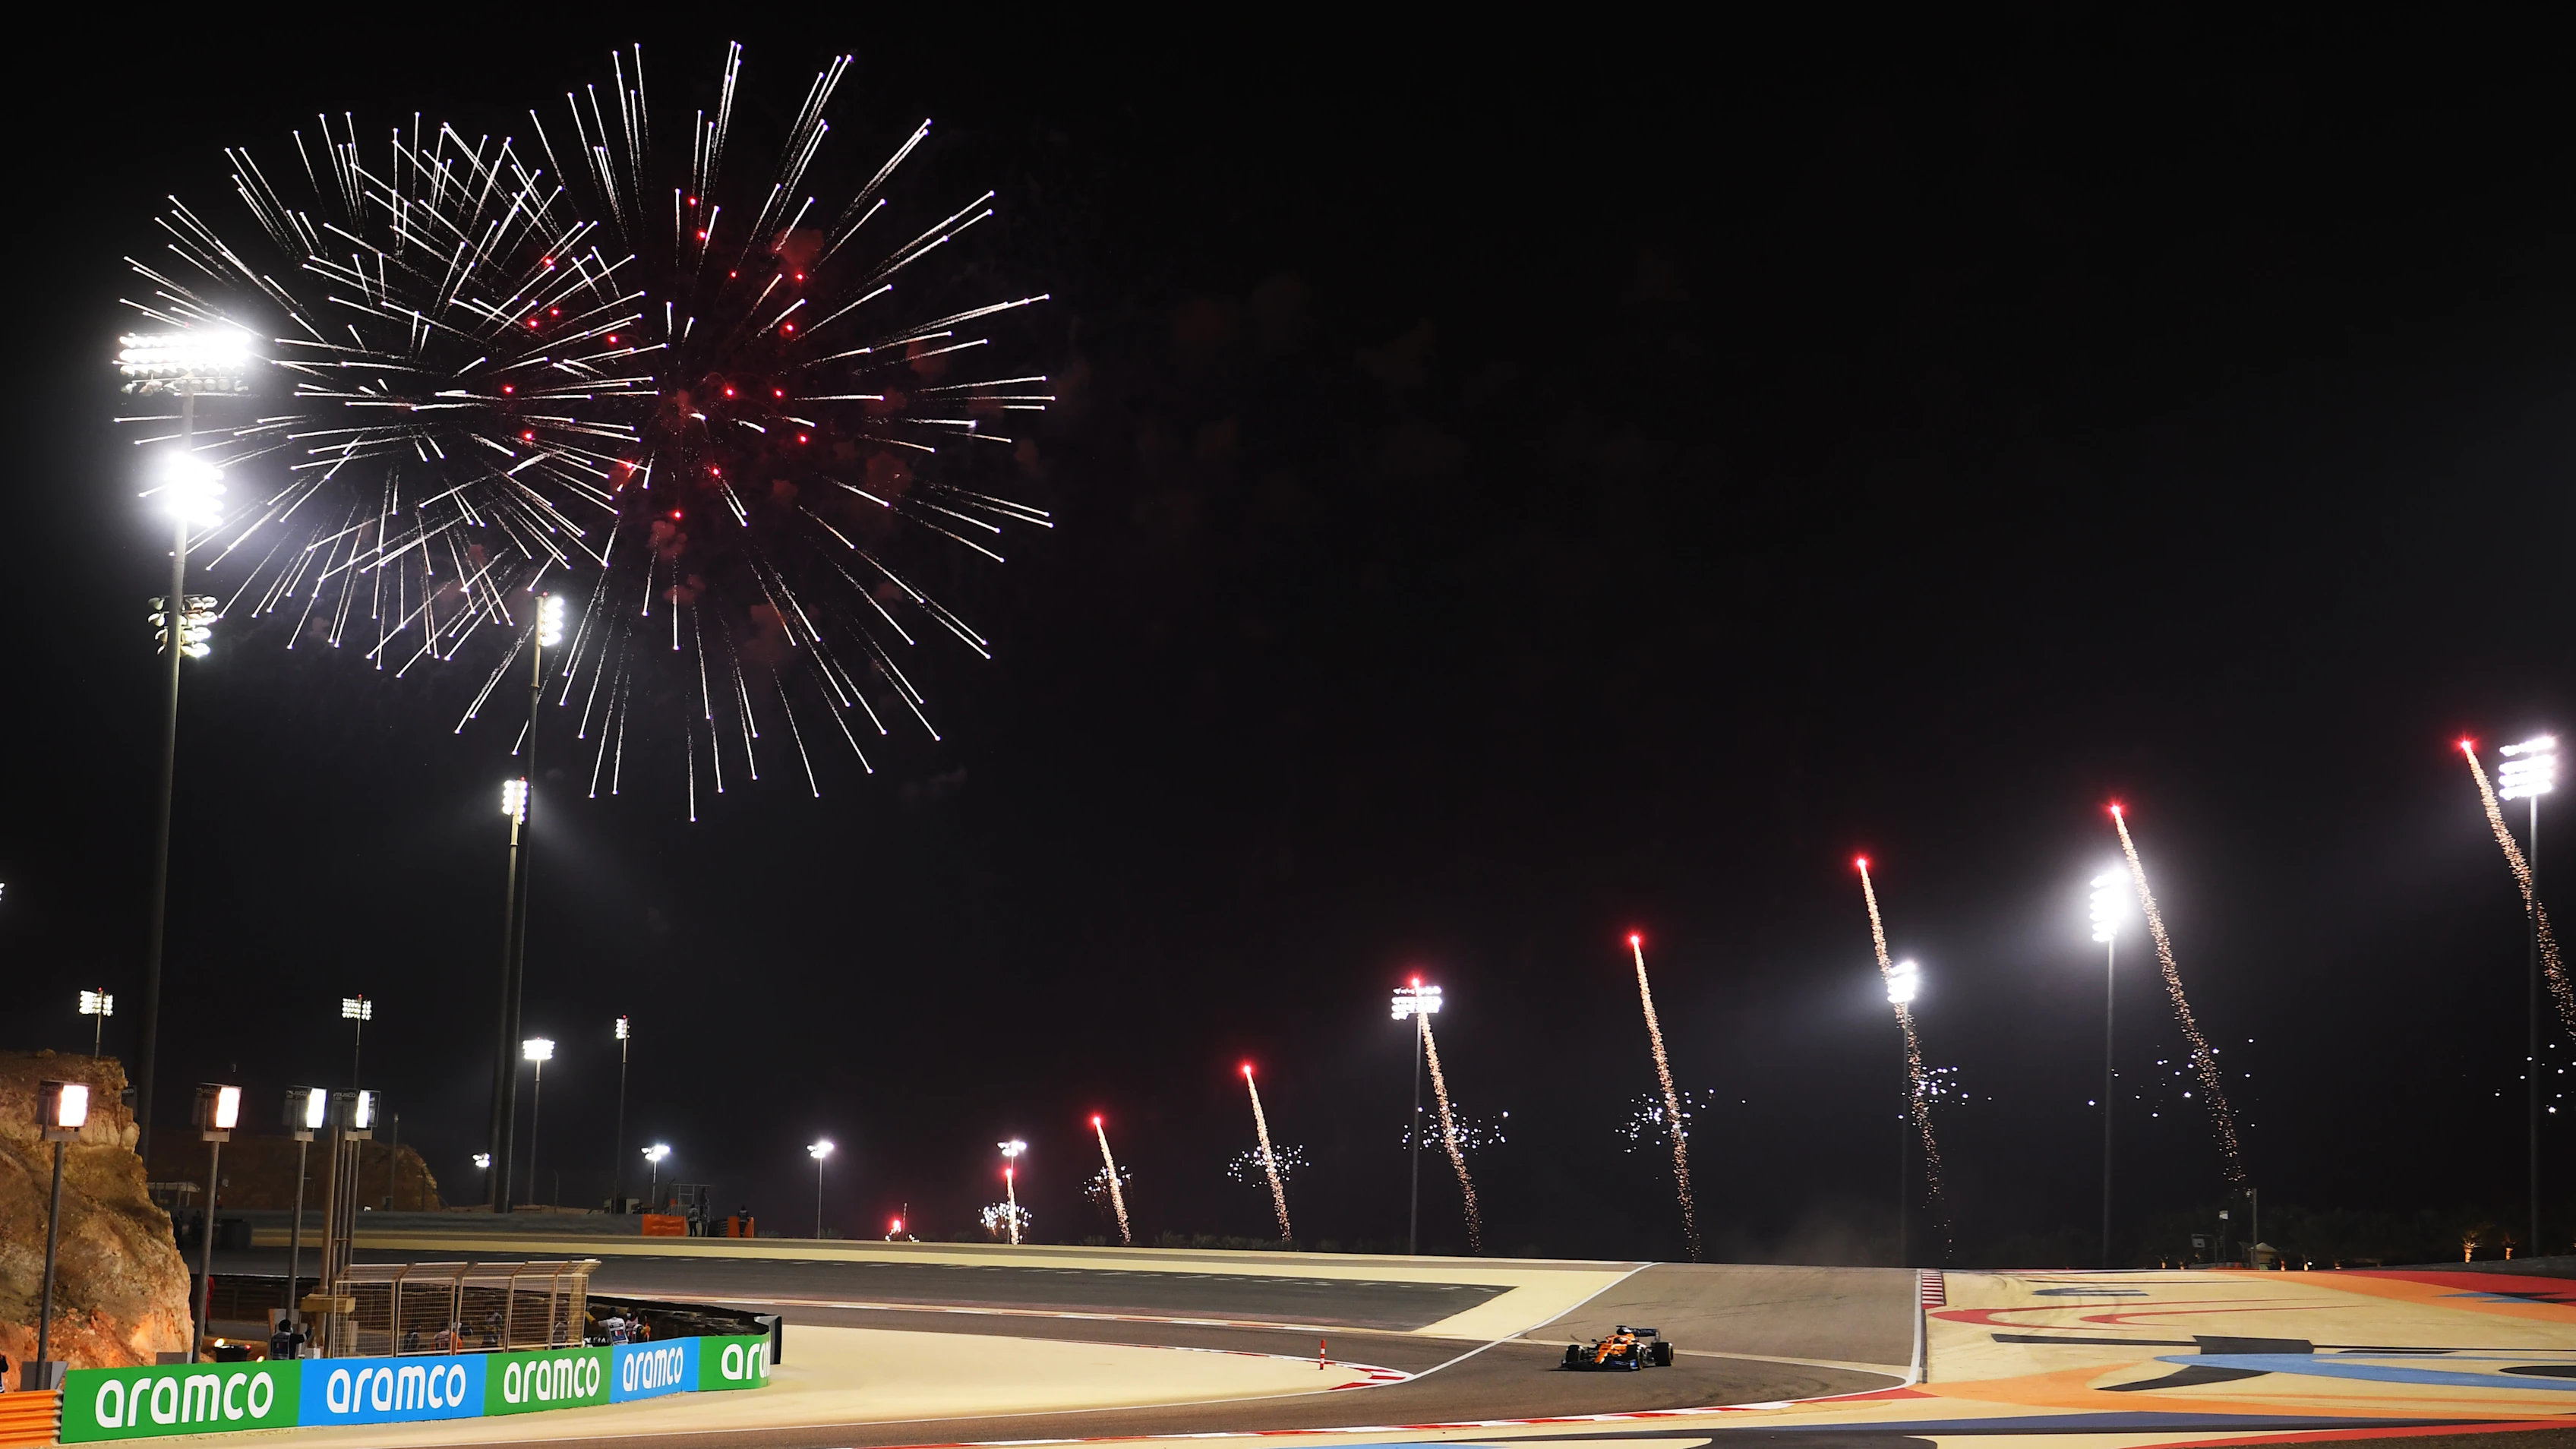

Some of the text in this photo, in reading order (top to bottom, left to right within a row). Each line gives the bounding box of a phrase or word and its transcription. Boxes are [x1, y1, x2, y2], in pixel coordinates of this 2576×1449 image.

[327, 1365, 466, 1413] aramco
[504, 1356, 600, 1403] aramco
[623, 1346, 683, 1391] aramco
[96, 1372, 274, 1428] aramco
